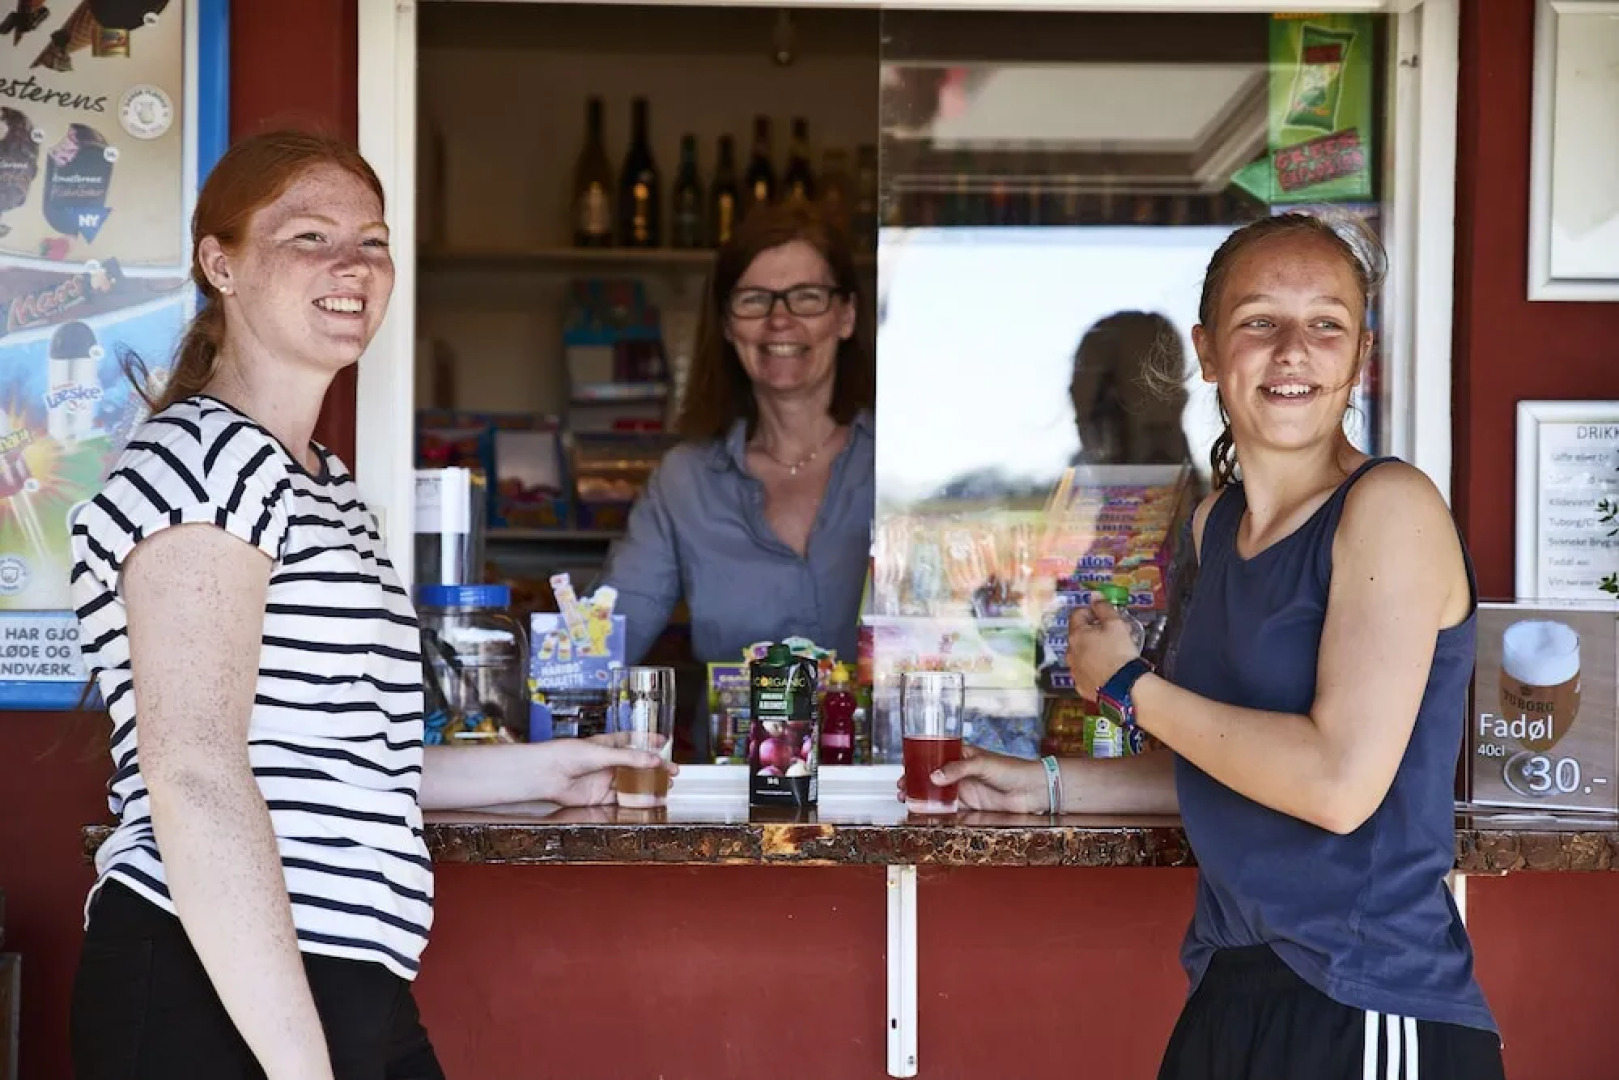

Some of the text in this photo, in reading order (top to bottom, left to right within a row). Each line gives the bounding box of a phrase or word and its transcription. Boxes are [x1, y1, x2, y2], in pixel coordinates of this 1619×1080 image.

[78, 213, 100, 227] NY
[7, 276, 84, 331] Mars
[5, 627, 39, 640] HAR
[45, 645, 71, 658] OG
[1502, 689, 1555, 713] TUBORG
[1479, 713, 1554, 741] Fadøl
[1477, 744, 1505, 757] 40cl
